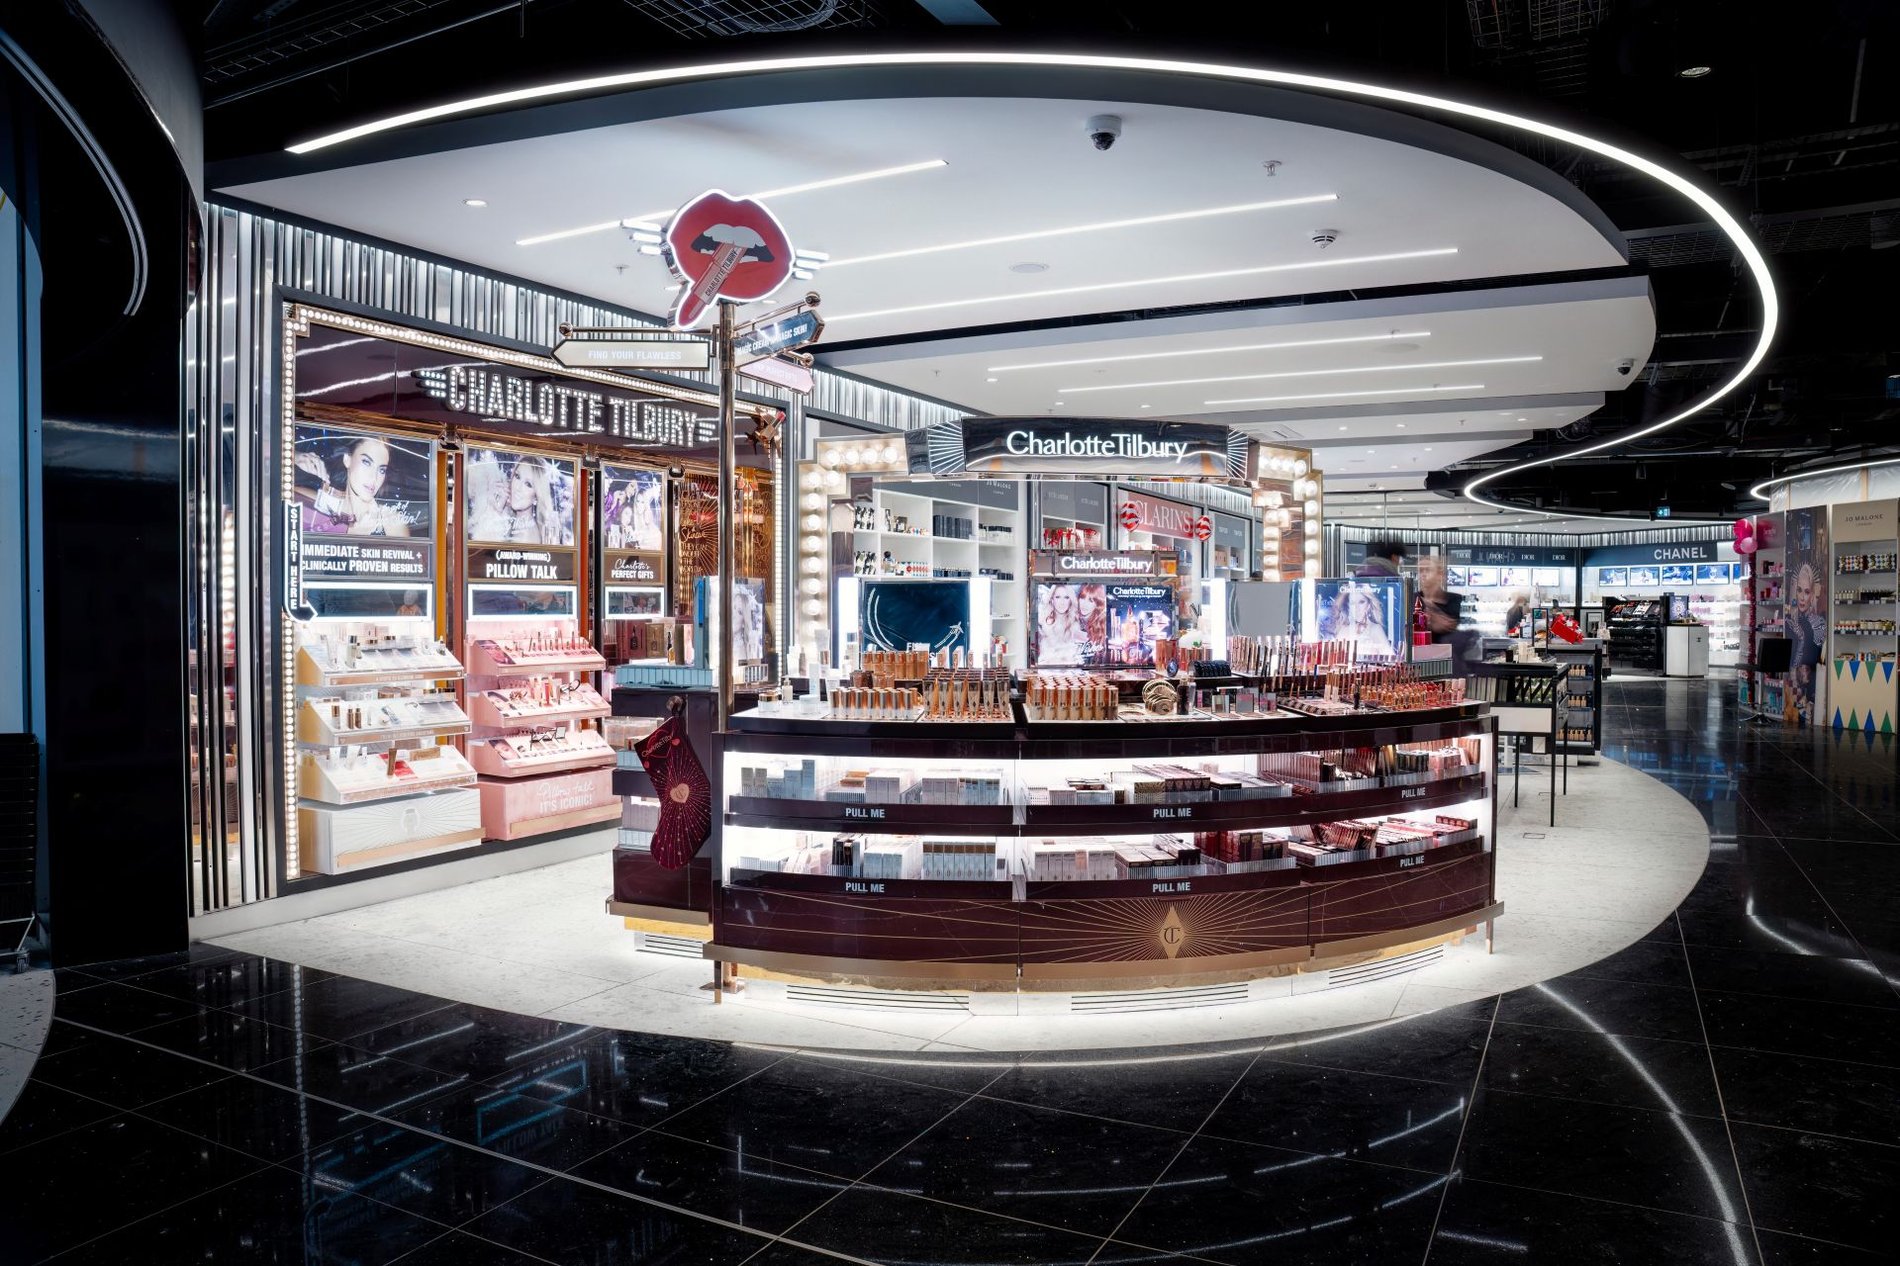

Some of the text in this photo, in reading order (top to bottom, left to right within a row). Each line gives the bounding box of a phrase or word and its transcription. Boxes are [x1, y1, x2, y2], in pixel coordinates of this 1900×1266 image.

[705, 249, 738, 297] CHARLOTTE TILBURY
[588, 350, 682, 360] FIND YOUR FLAWLESS
[446, 365, 698, 448] CHARLOTTE TILBURY
[289, 508, 300, 562] START
[301, 543, 359, 558] IMMEDIATE
[361, 549, 380, 559] SKIN
[382, 549, 415, 560] REVIVAL
[495, 549, 551, 562] (AWARD-WINNING)
[1653, 546, 1708, 560] CHANEL
[301, 560, 423, 573] CLINICALLY PROVEN RESULTS
[486, 563, 558, 579] PILLOW TALK
[611, 569, 654, 580] PERFECT GIFTS
[289, 565, 299, 610] HERE
[1401, 787, 1426, 798] PULL ME
[540, 794, 593, 814] IT'S ICONIC!
[845, 807, 886, 819] PULL ME
[1153, 807, 1192, 818] PULL ME
[1400, 855, 1425, 867] PULL ME
[845, 882, 885, 893] PULL ME
[1152, 881, 1191, 893] PULL ME
